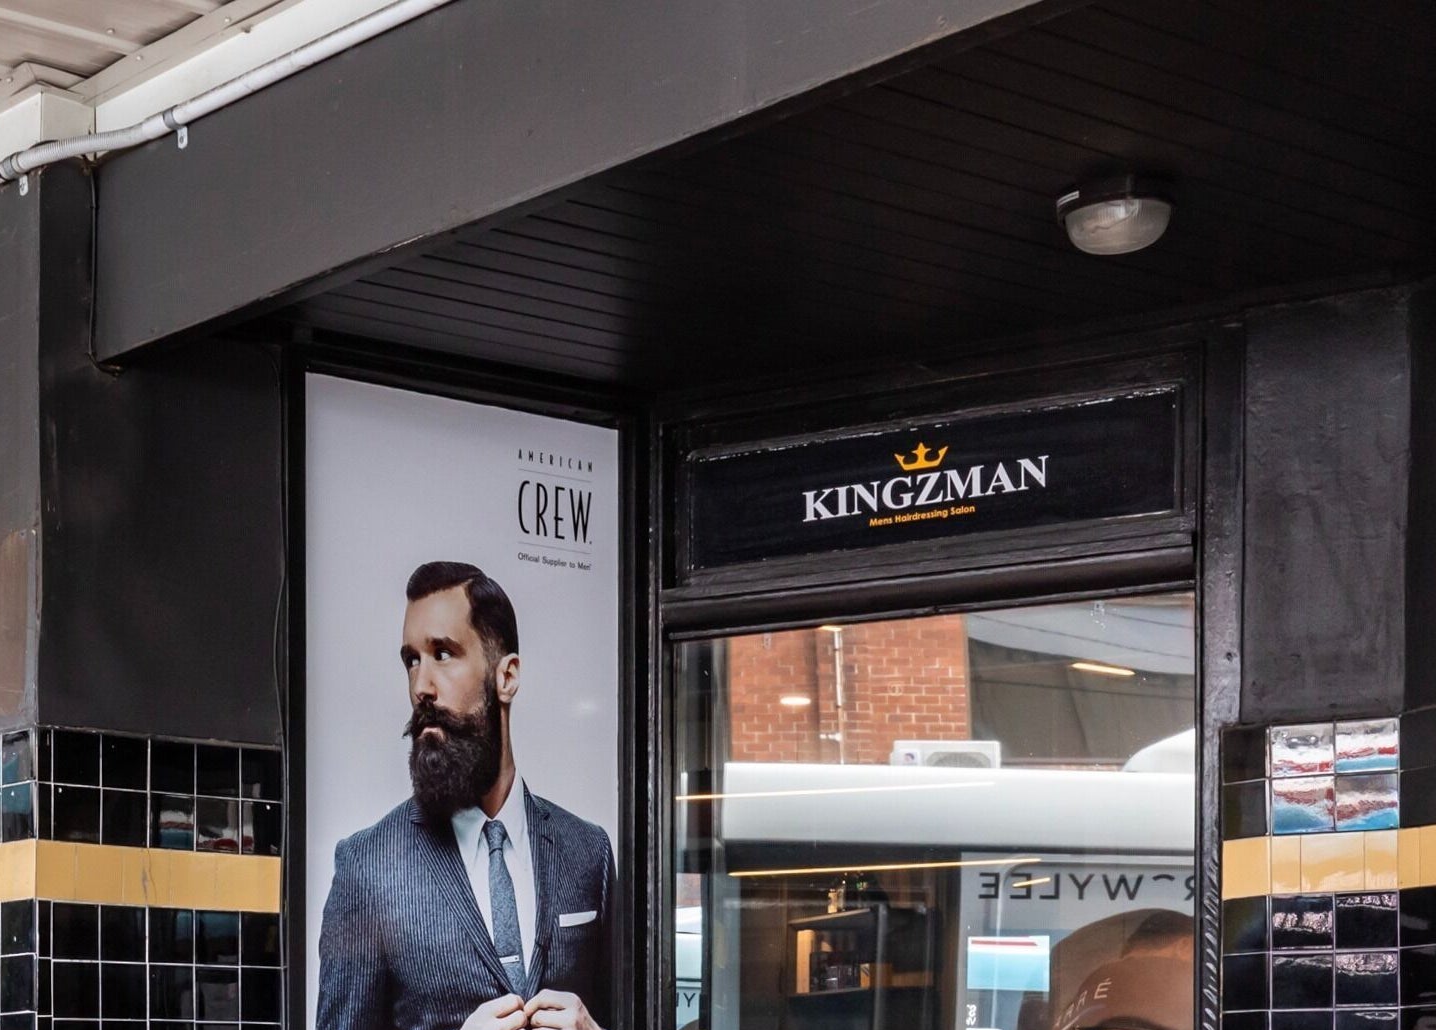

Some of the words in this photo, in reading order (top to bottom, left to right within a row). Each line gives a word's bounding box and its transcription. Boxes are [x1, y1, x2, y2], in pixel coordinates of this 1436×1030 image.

[518, 448, 593, 472] AMERICAN
[802, 455, 1050, 522] KINGZMAN
[869, 517, 893, 527] Mens
[894, 509, 948, 523] Hairdressing
[950, 505, 976, 516] Salon
[517, 552, 540, 563] Official
[541, 556, 567, 567] Supplier
[569, 561, 576, 569] to
